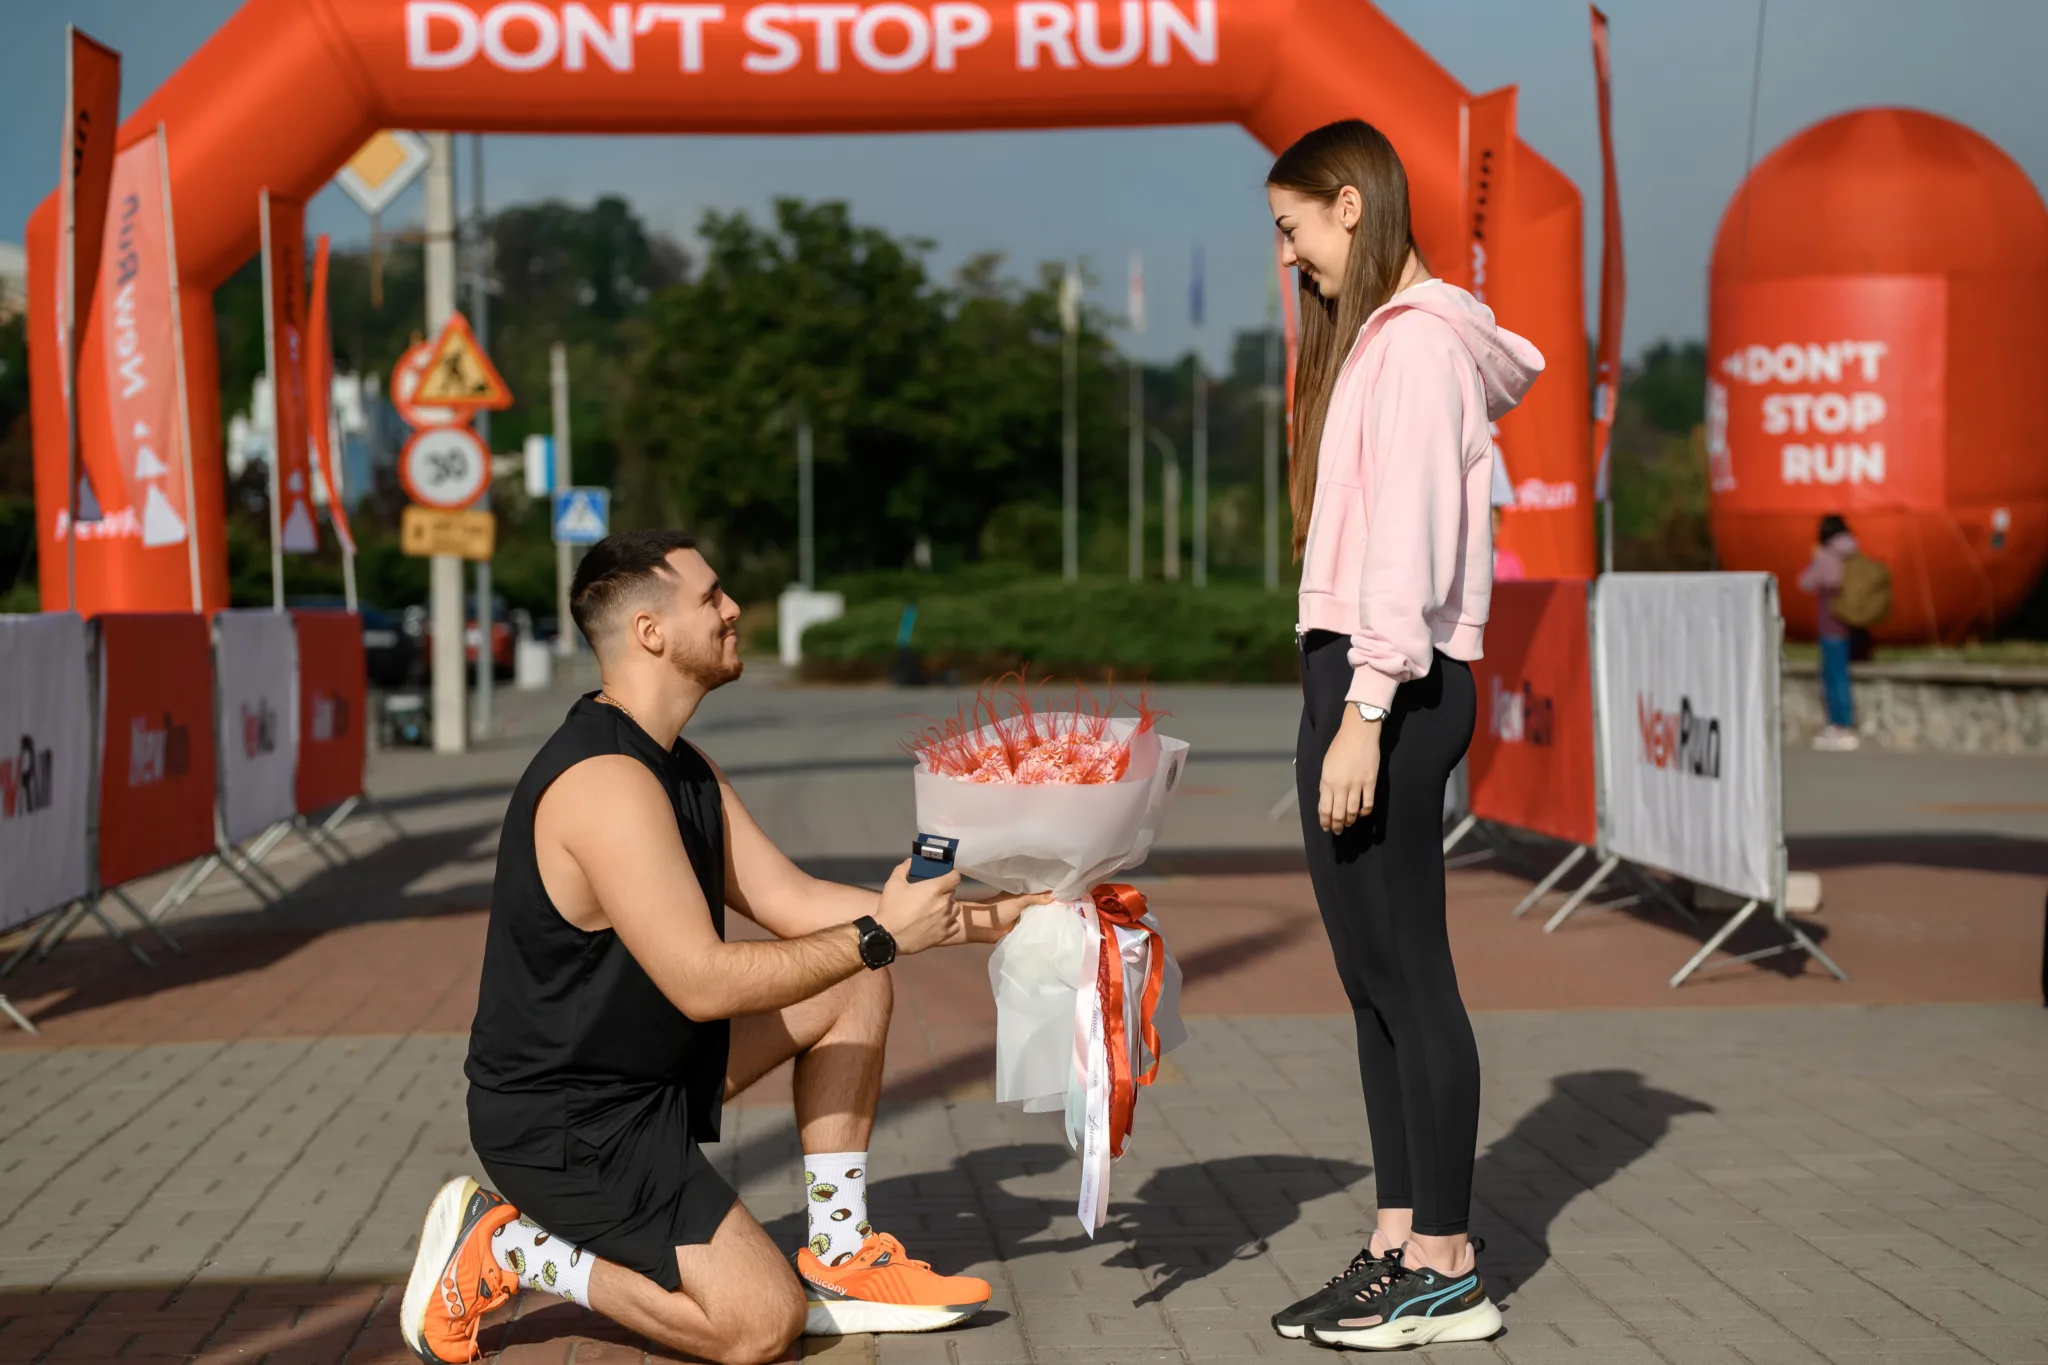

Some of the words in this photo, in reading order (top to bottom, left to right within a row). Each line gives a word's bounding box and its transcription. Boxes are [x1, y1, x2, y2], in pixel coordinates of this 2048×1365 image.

[405, 1, 724, 73] DON'T
[743, 2, 991, 74] STOP
[1016, 0, 1219, 69] RUN
[1746, 339, 1889, 385] DON'T
[1762, 391, 1887, 434] STOP
[1782, 442, 1886, 485] RUN
[803, 1271, 848, 1296] saucony
